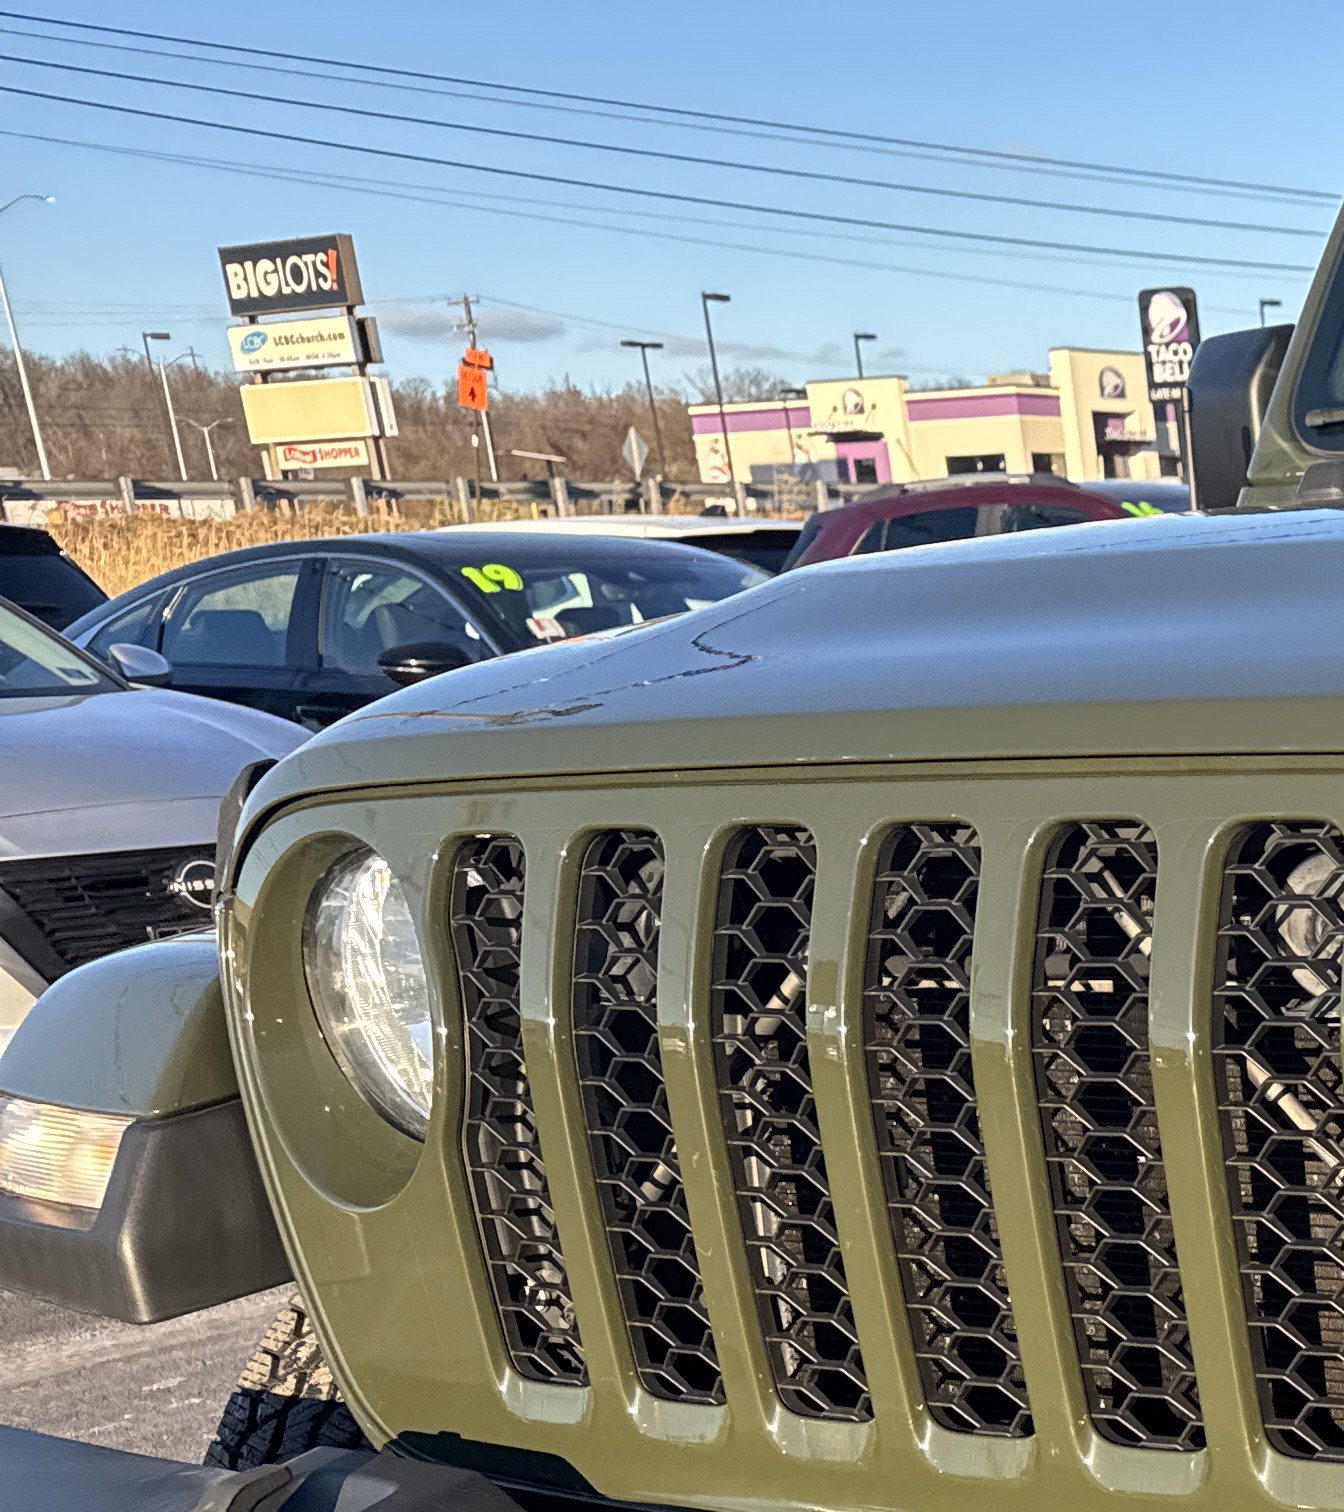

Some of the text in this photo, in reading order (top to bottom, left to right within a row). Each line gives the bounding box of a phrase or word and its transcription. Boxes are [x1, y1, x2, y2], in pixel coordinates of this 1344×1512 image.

[1147, 341, 1193, 362] TACO
[460, 563, 524, 594] 19
[173, 878, 215, 893] NISS
